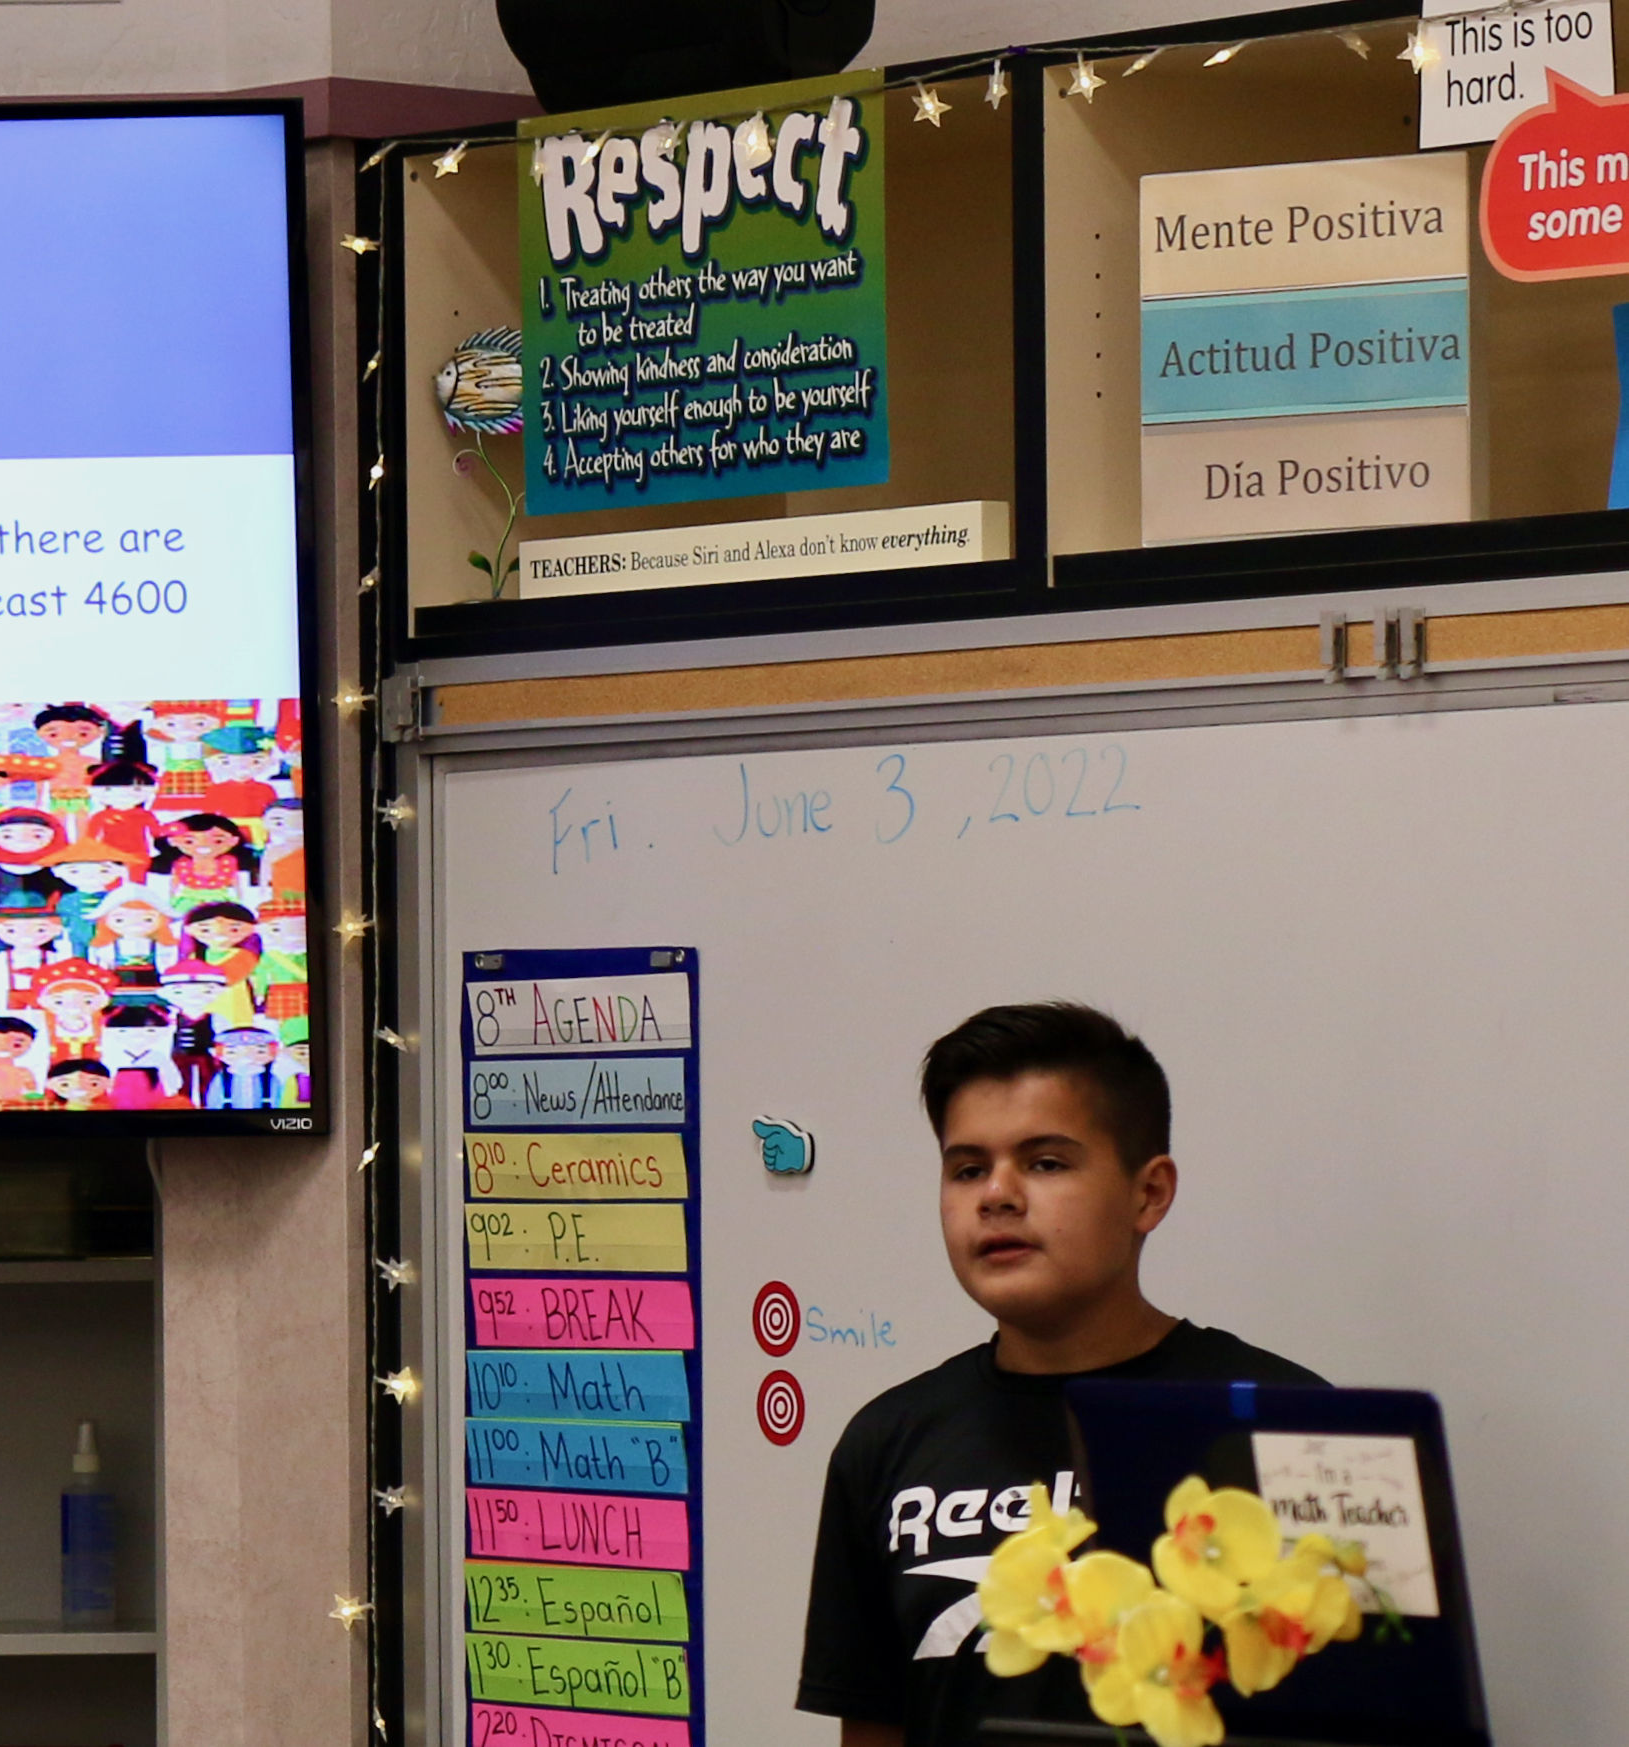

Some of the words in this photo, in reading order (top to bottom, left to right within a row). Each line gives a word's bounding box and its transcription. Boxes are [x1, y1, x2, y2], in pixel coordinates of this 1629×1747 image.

[1445, 16, 1503, 57] This
[1513, 12, 1535, 48] is
[1545, 8, 1593, 43] too
[1447, 61, 1524, 108] hard.
[540, 96, 862, 262] Respect
[1518, 148, 1585, 192] This
[1154, 213, 1274, 253] Mente
[1287, 200, 1444, 244] Positiva
[1527, 203, 1623, 241] some
[560, 276, 631, 316] Treating
[638, 266, 692, 301] others
[697, 260, 726, 292] the
[732, 266, 770, 295] way
[773, 263, 805, 293] you
[810, 251, 858, 281] want
[578, 321, 597, 346] to
[601, 311, 623, 346] be
[628, 302, 696, 340] treated
[539, 355, 555, 390] 2.
[560, 354, 629, 396] Showing
[636, 346, 701, 383] kindness
[705, 338, 738, 374] and
[744, 332, 853, 371] consideration
[1159, 332, 1296, 378] Actitud
[1309, 328, 1460, 369] Positiva
[541, 401, 556, 432] 3.
[561, 400, 608, 443] Liking
[613, 389, 680, 435] yourself
[683, 383, 742, 429] enough
[747, 387, 768, 412] to
[772, 376, 796, 410] be
[801, 368, 871, 416] yourself
[542, 444, 557, 476] 4.
[563, 437, 644, 484] Accepting
[650, 435, 704, 468] others
[709, 429, 737, 468] for
[743, 425, 780, 459] who
[785, 422, 825, 465] they
[830, 428, 861, 450] are
[1205, 460, 1264, 500] Día
[1277, 454, 1430, 497] Positivo
[119, 524, 186, 553] are
[530, 553, 627, 579] TEACHERS:
[630, 549, 689, 571] Because
[692, 545, 720, 565] Siri
[723, 542, 751, 564] and
[754, 538, 796, 560] Alexa
[799, 534, 836, 557] don't
[839, 532, 878, 553] know
[881, 524, 970, 551] everything.
[83, 580, 188, 617] 4600
[712, 762, 833, 847] June
[270, 1117, 313, 1130] VIZIO
[526, 1142, 663, 1189] Ceramics
[547, 1210, 600, 1264] P.E.
[541, 1287, 655, 1345] BREAK
[806, 1306, 896, 1349] Smile
[548, 1361, 646, 1412] Math
[539, 1430, 625, 1482] Math
[537, 1499, 643, 1560] LUNCH
[537, 1576, 662, 1635] Español
[526, 1646, 646, 1707] Español
